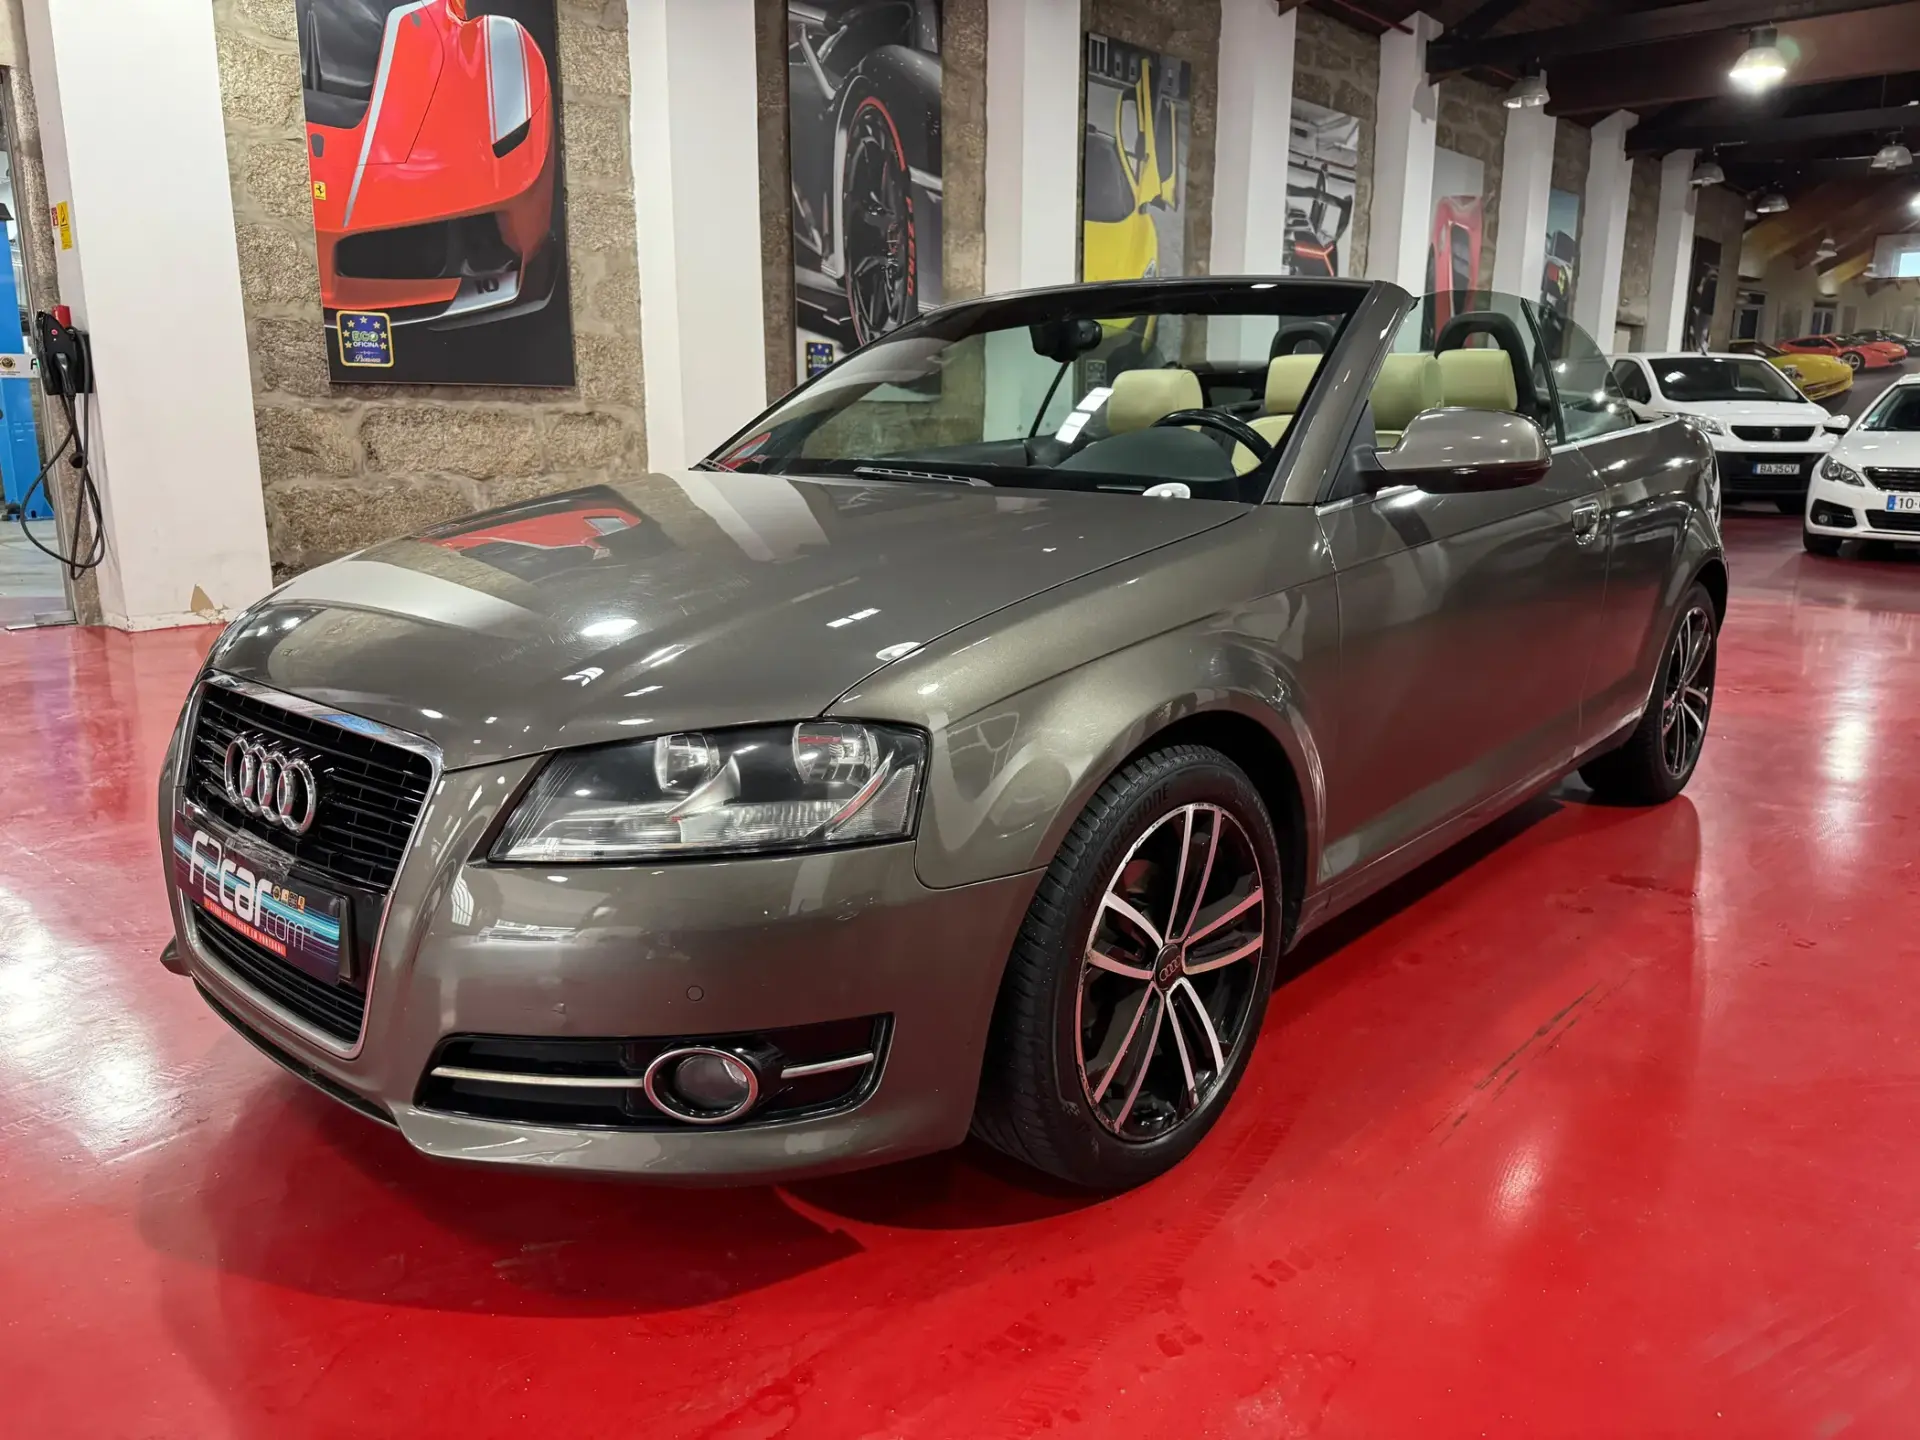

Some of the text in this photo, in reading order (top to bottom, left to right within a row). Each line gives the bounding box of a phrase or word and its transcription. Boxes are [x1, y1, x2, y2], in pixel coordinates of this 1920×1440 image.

[907, 220, 916, 296] ZERO
[475, 279, 499, 295] 10
[351, 330, 379, 342] ECO
[1899, 497, 1920, 510] 10-
